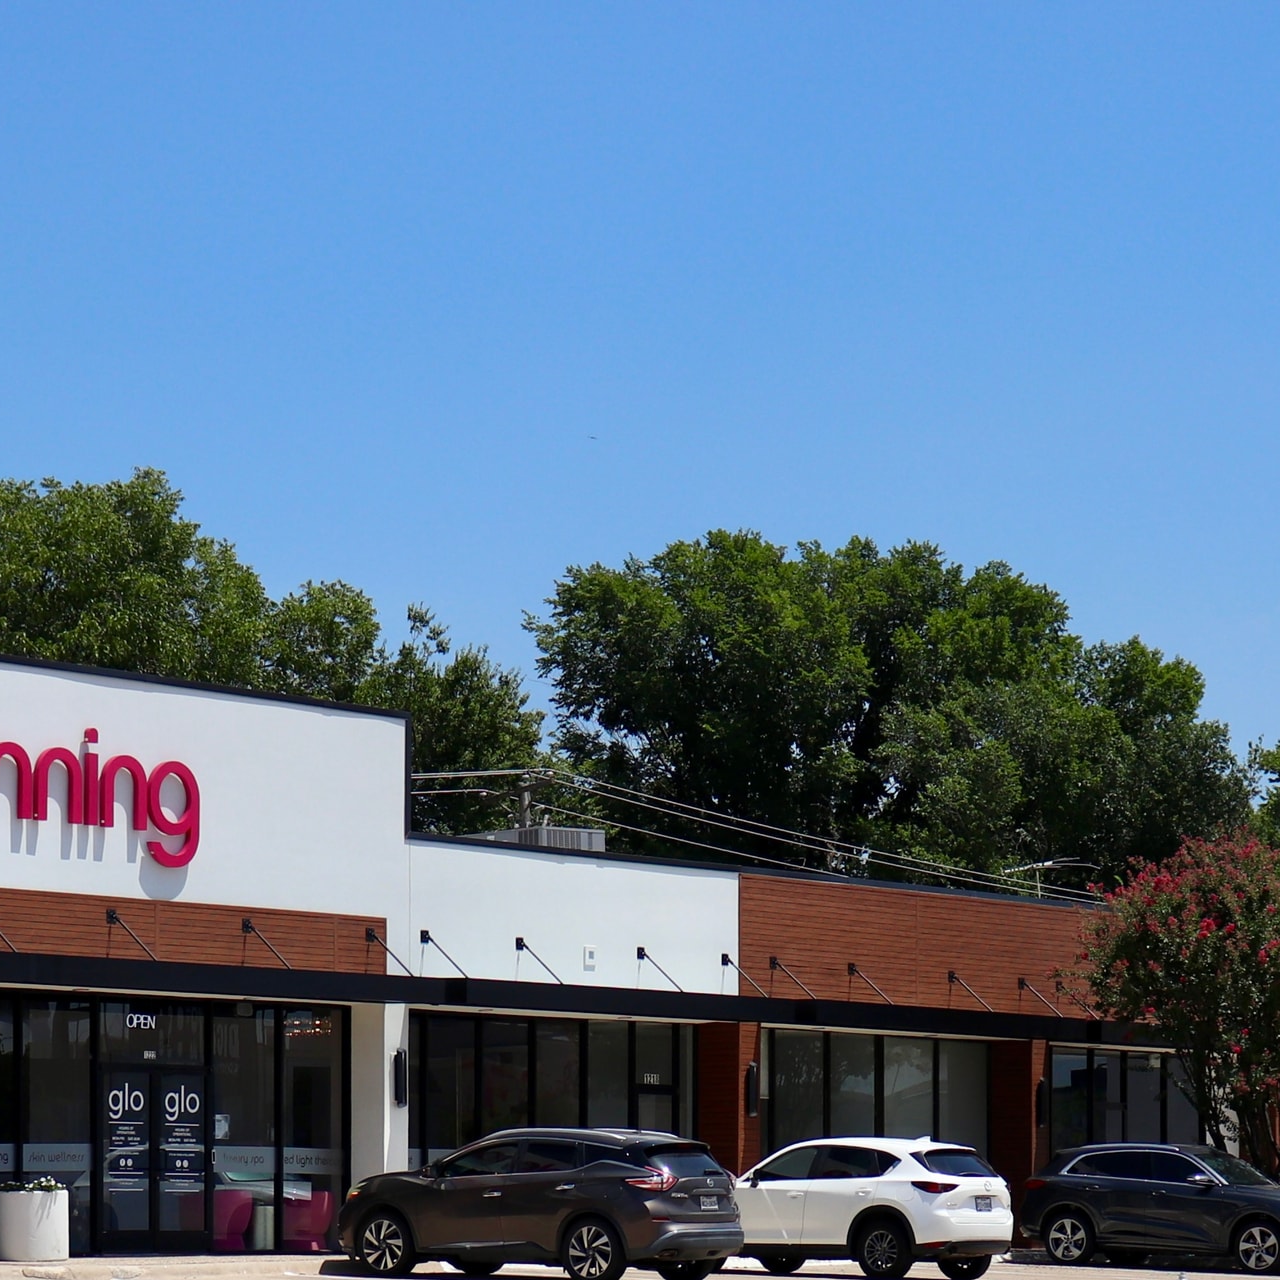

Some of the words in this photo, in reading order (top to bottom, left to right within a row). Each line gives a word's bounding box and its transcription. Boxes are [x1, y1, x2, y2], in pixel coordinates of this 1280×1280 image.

[126, 1013, 156, 1029] OPEN
[108, 1082, 144, 1119] glo
[165, 1084, 200, 1121] glo
[29, 1151, 46, 1163] skin
[48, 1152, 85, 1162] wellness
[250, 1155, 265, 1166] spa
[296, 1153, 313, 1168] light
